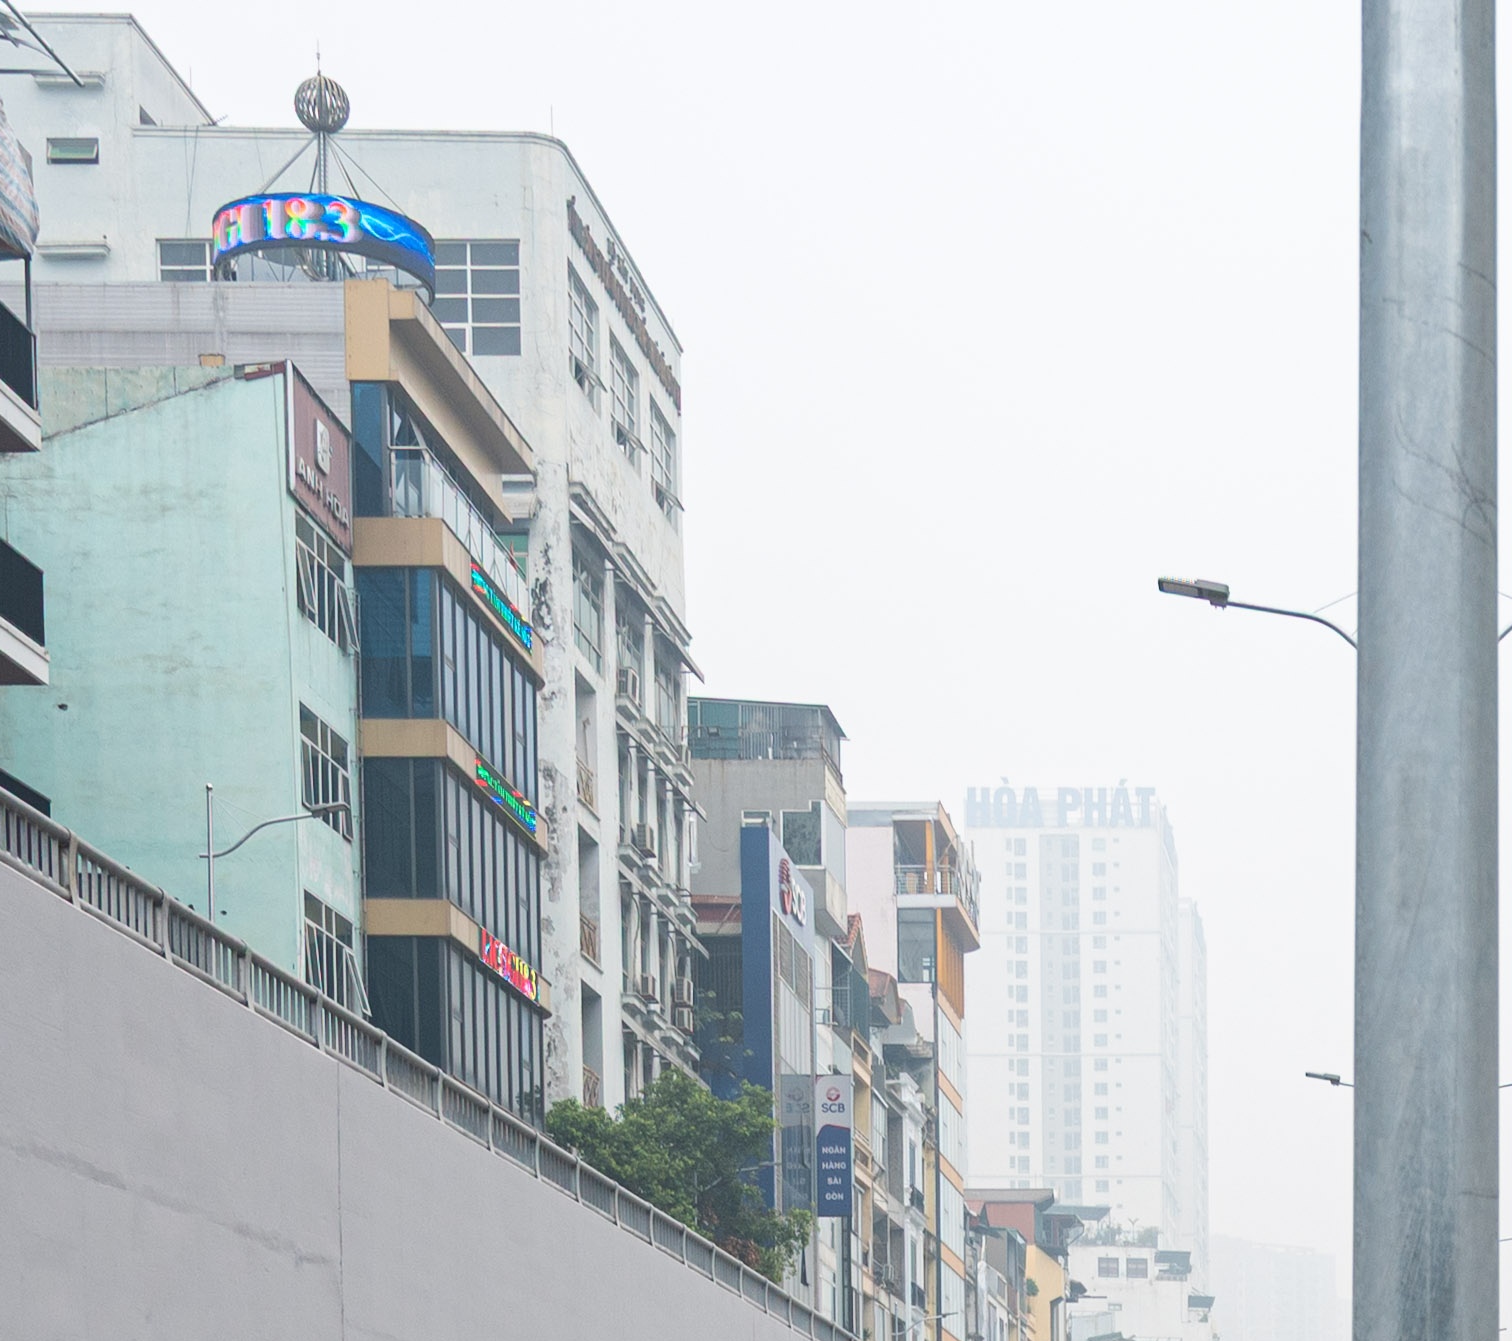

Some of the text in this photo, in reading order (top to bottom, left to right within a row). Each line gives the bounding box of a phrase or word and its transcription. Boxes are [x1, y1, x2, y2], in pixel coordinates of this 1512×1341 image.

[263, 198, 362, 243] 18.3
[296, 457, 323, 499] ANH
[966, 777, 1156, 828] HÒA PHÁT
[792, 878, 806, 926] SCB
[821, 1103, 845, 1113] SCB
